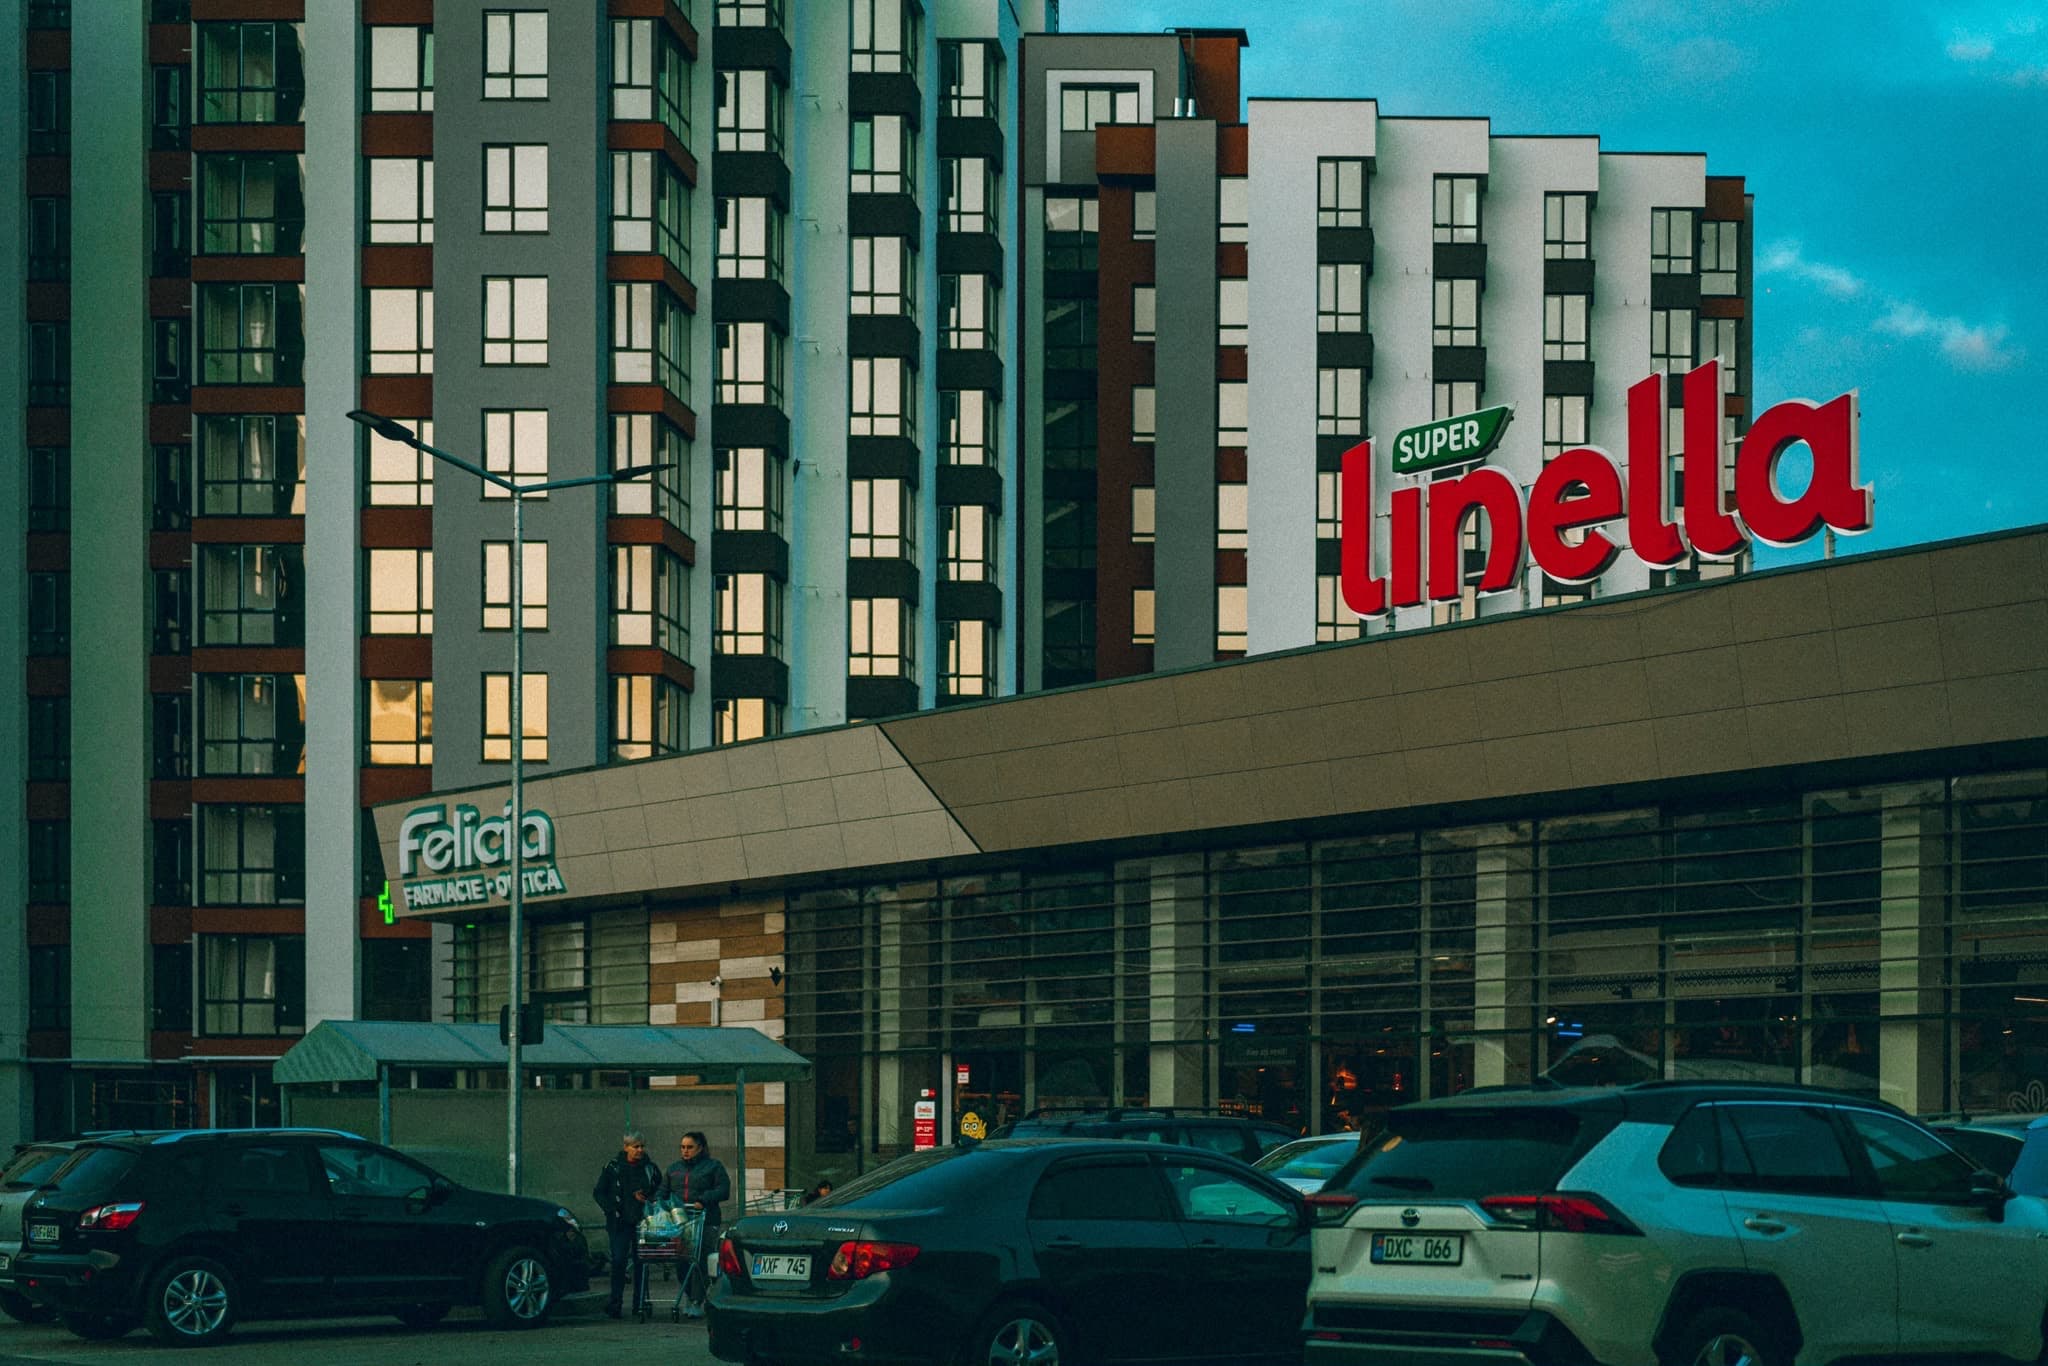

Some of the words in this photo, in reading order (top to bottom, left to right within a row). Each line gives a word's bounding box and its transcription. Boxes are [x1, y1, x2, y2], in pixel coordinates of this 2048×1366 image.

[1399, 420, 1480, 463] SUPER
[1341, 356, 1874, 621] linella
[399, 803, 552, 876] Felicia
[403, 878, 487, 909] FARMACIE
[761, 1257, 780, 1274] XXF
[787, 1258, 806, 1275] 745
[1385, 1238, 1412, 1258] DXC
[1424, 1239, 1451, 1259] 066
